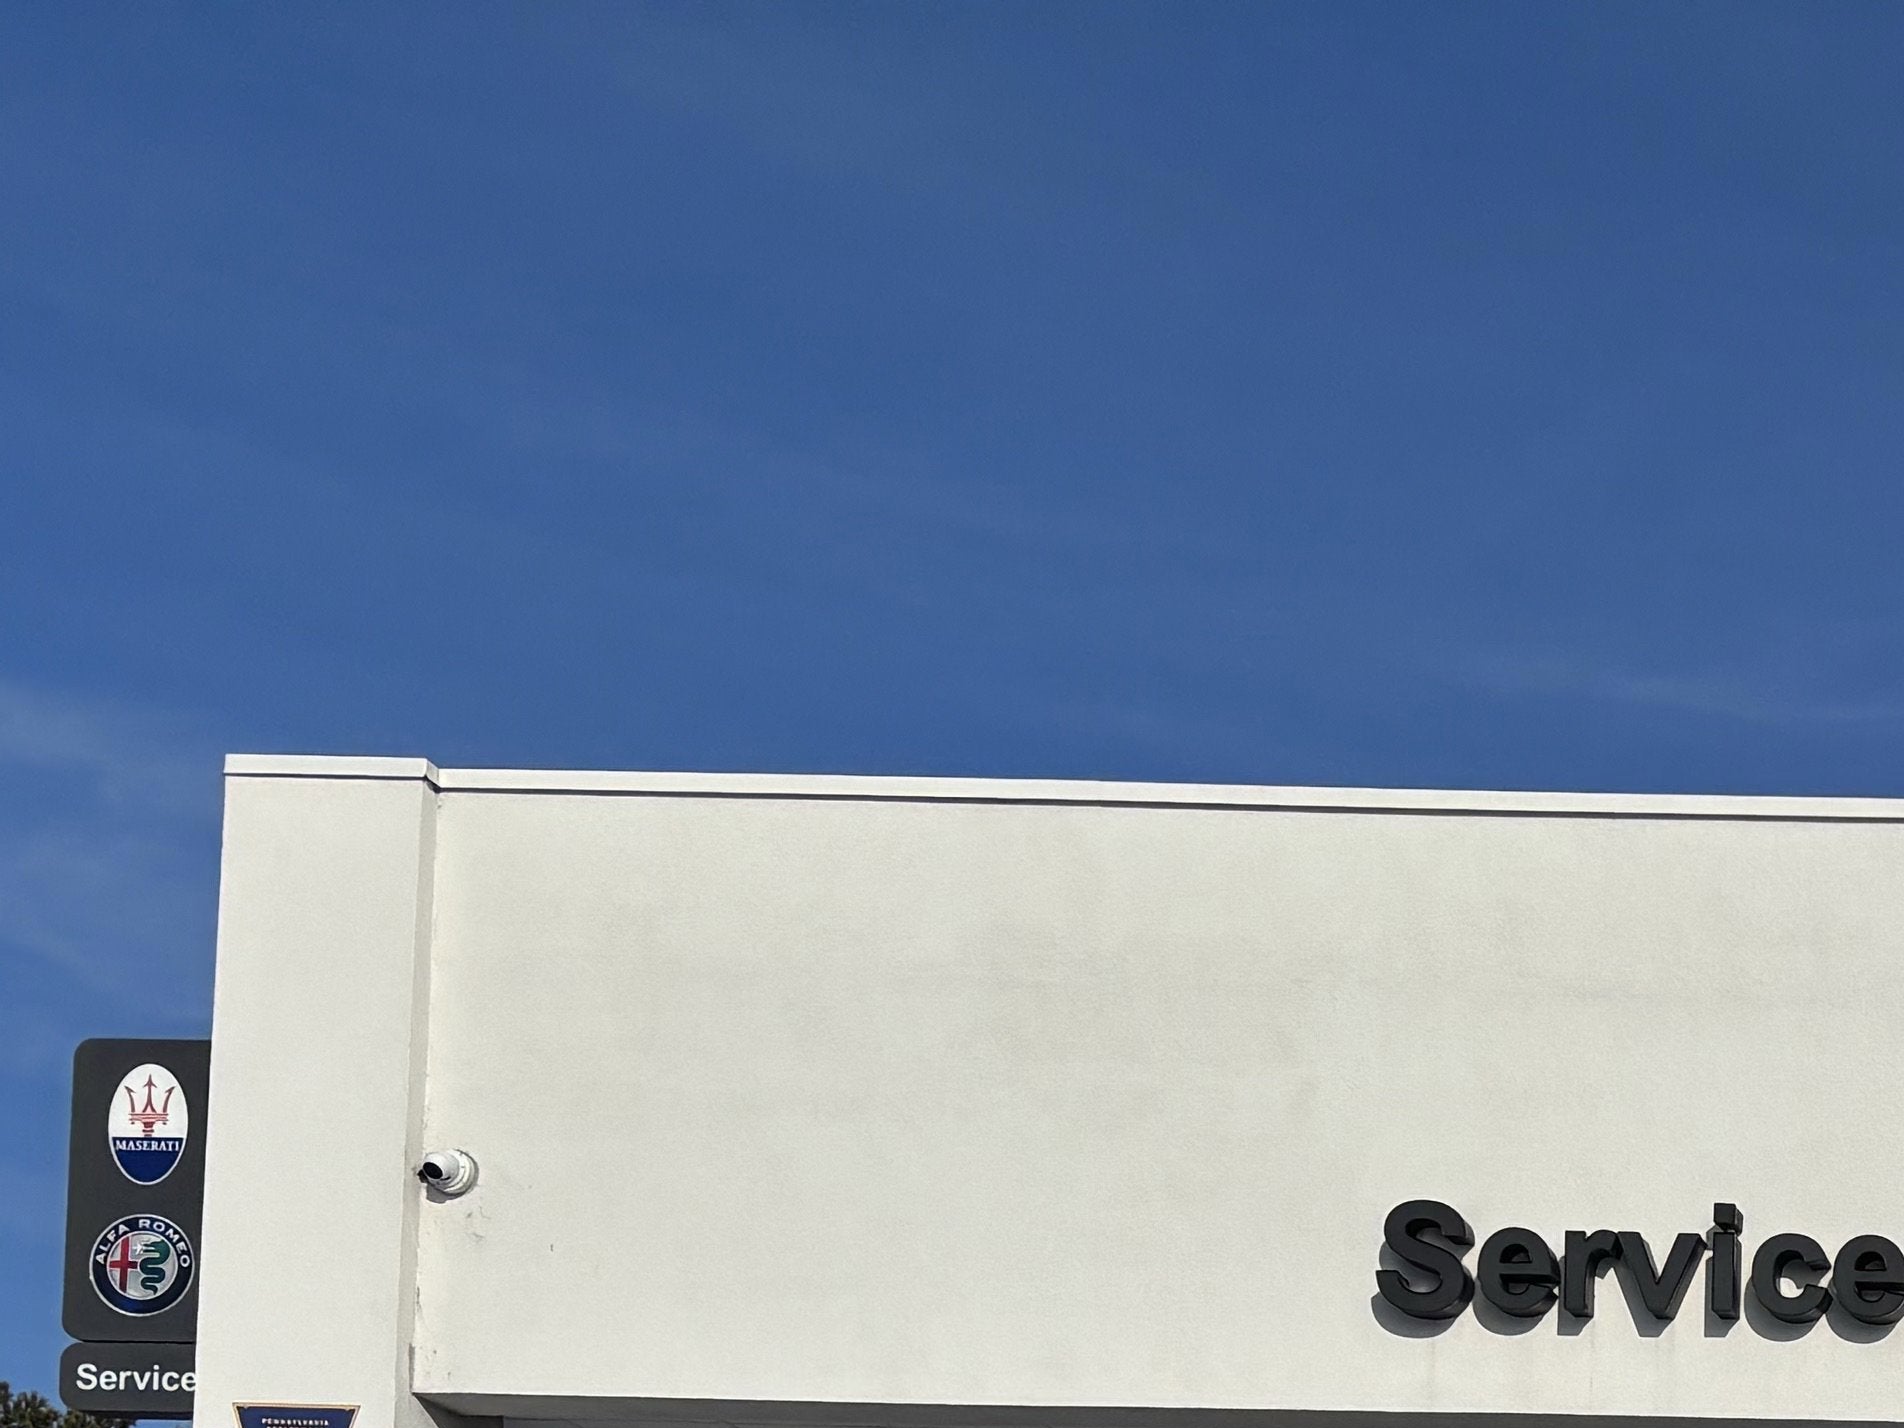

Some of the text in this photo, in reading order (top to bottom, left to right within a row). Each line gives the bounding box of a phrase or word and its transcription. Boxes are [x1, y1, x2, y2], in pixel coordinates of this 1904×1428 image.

[115, 1140, 180, 1152] MASERATI
[95, 1218, 191, 1268] ALFA ROMEO
[76, 1363, 196, 1392] Service
